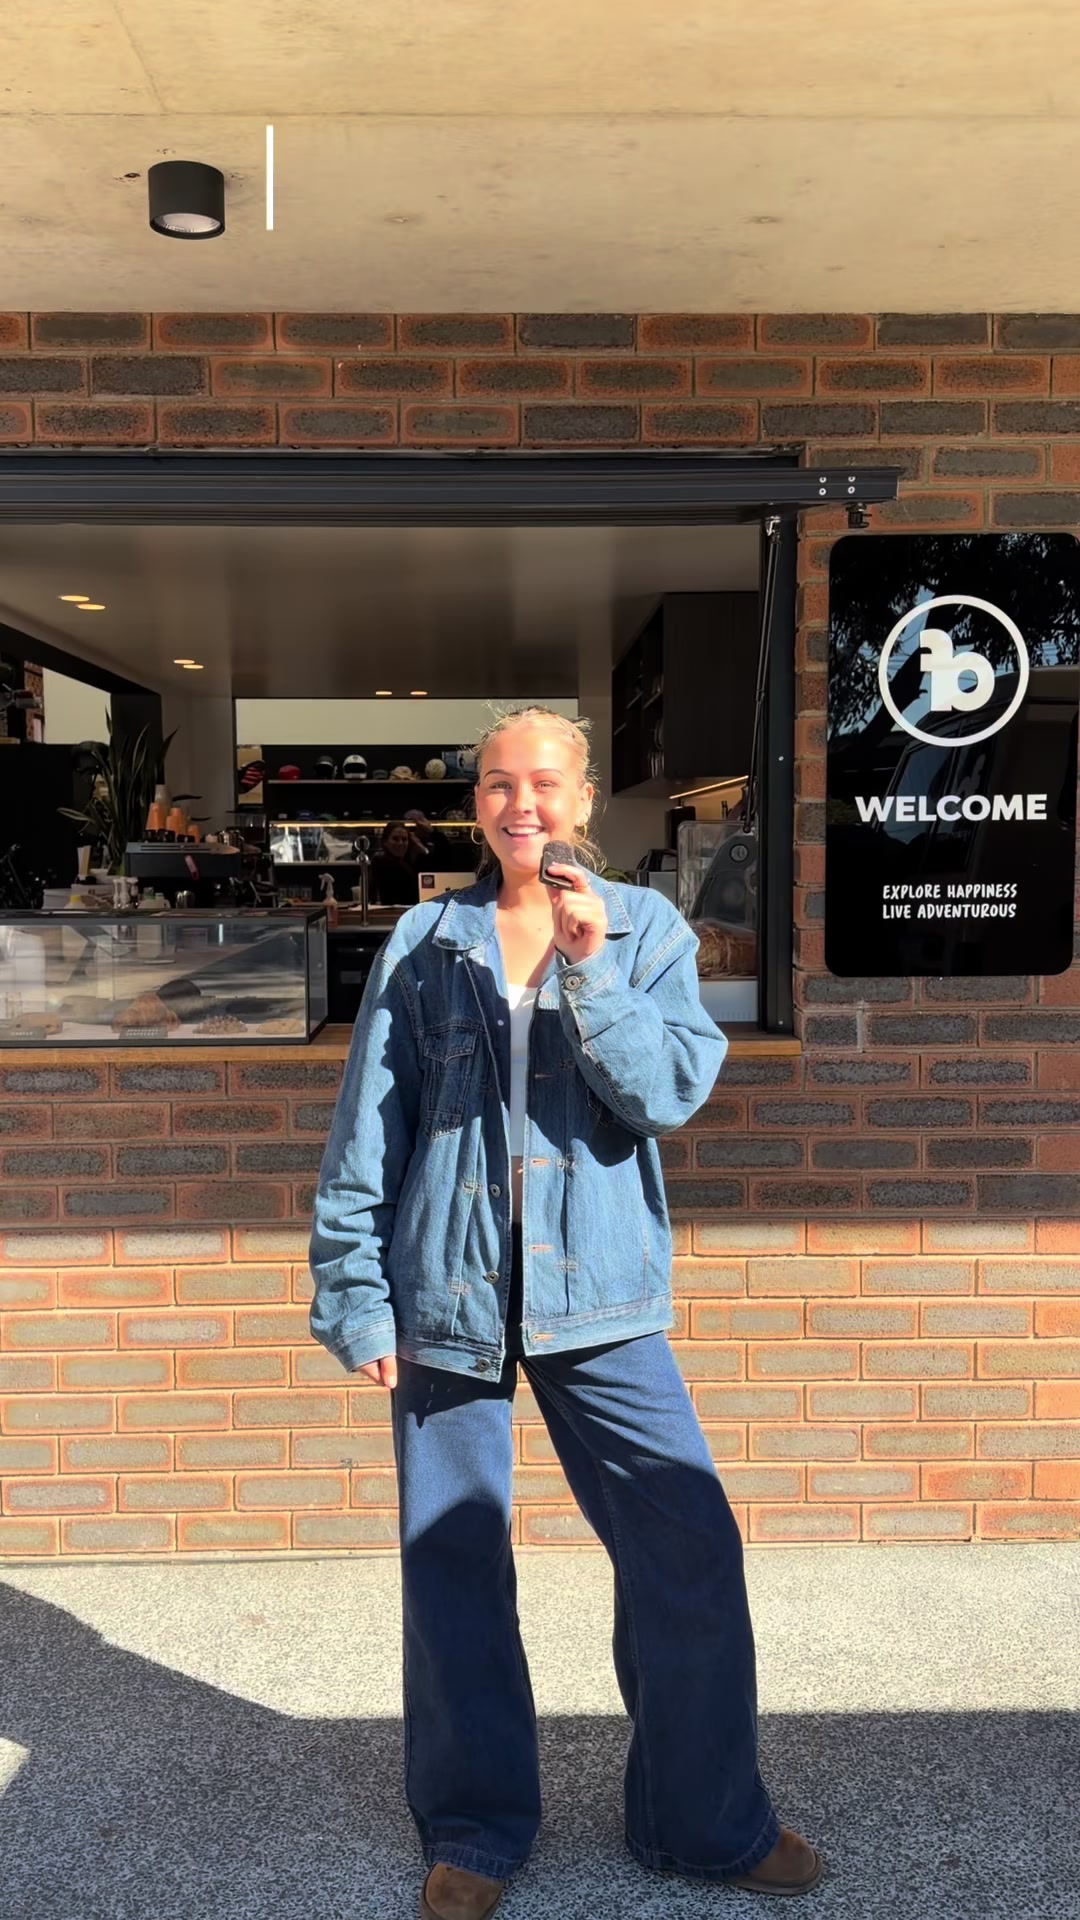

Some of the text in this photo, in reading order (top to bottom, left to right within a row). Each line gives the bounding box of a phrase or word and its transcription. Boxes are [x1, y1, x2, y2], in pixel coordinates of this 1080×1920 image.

[854, 793, 1048, 823] WELCOME
[882, 882, 1018, 900] EXPLORE HAPPINESS
[882, 903, 1017, 920] LIVE ADVENTUROUS
